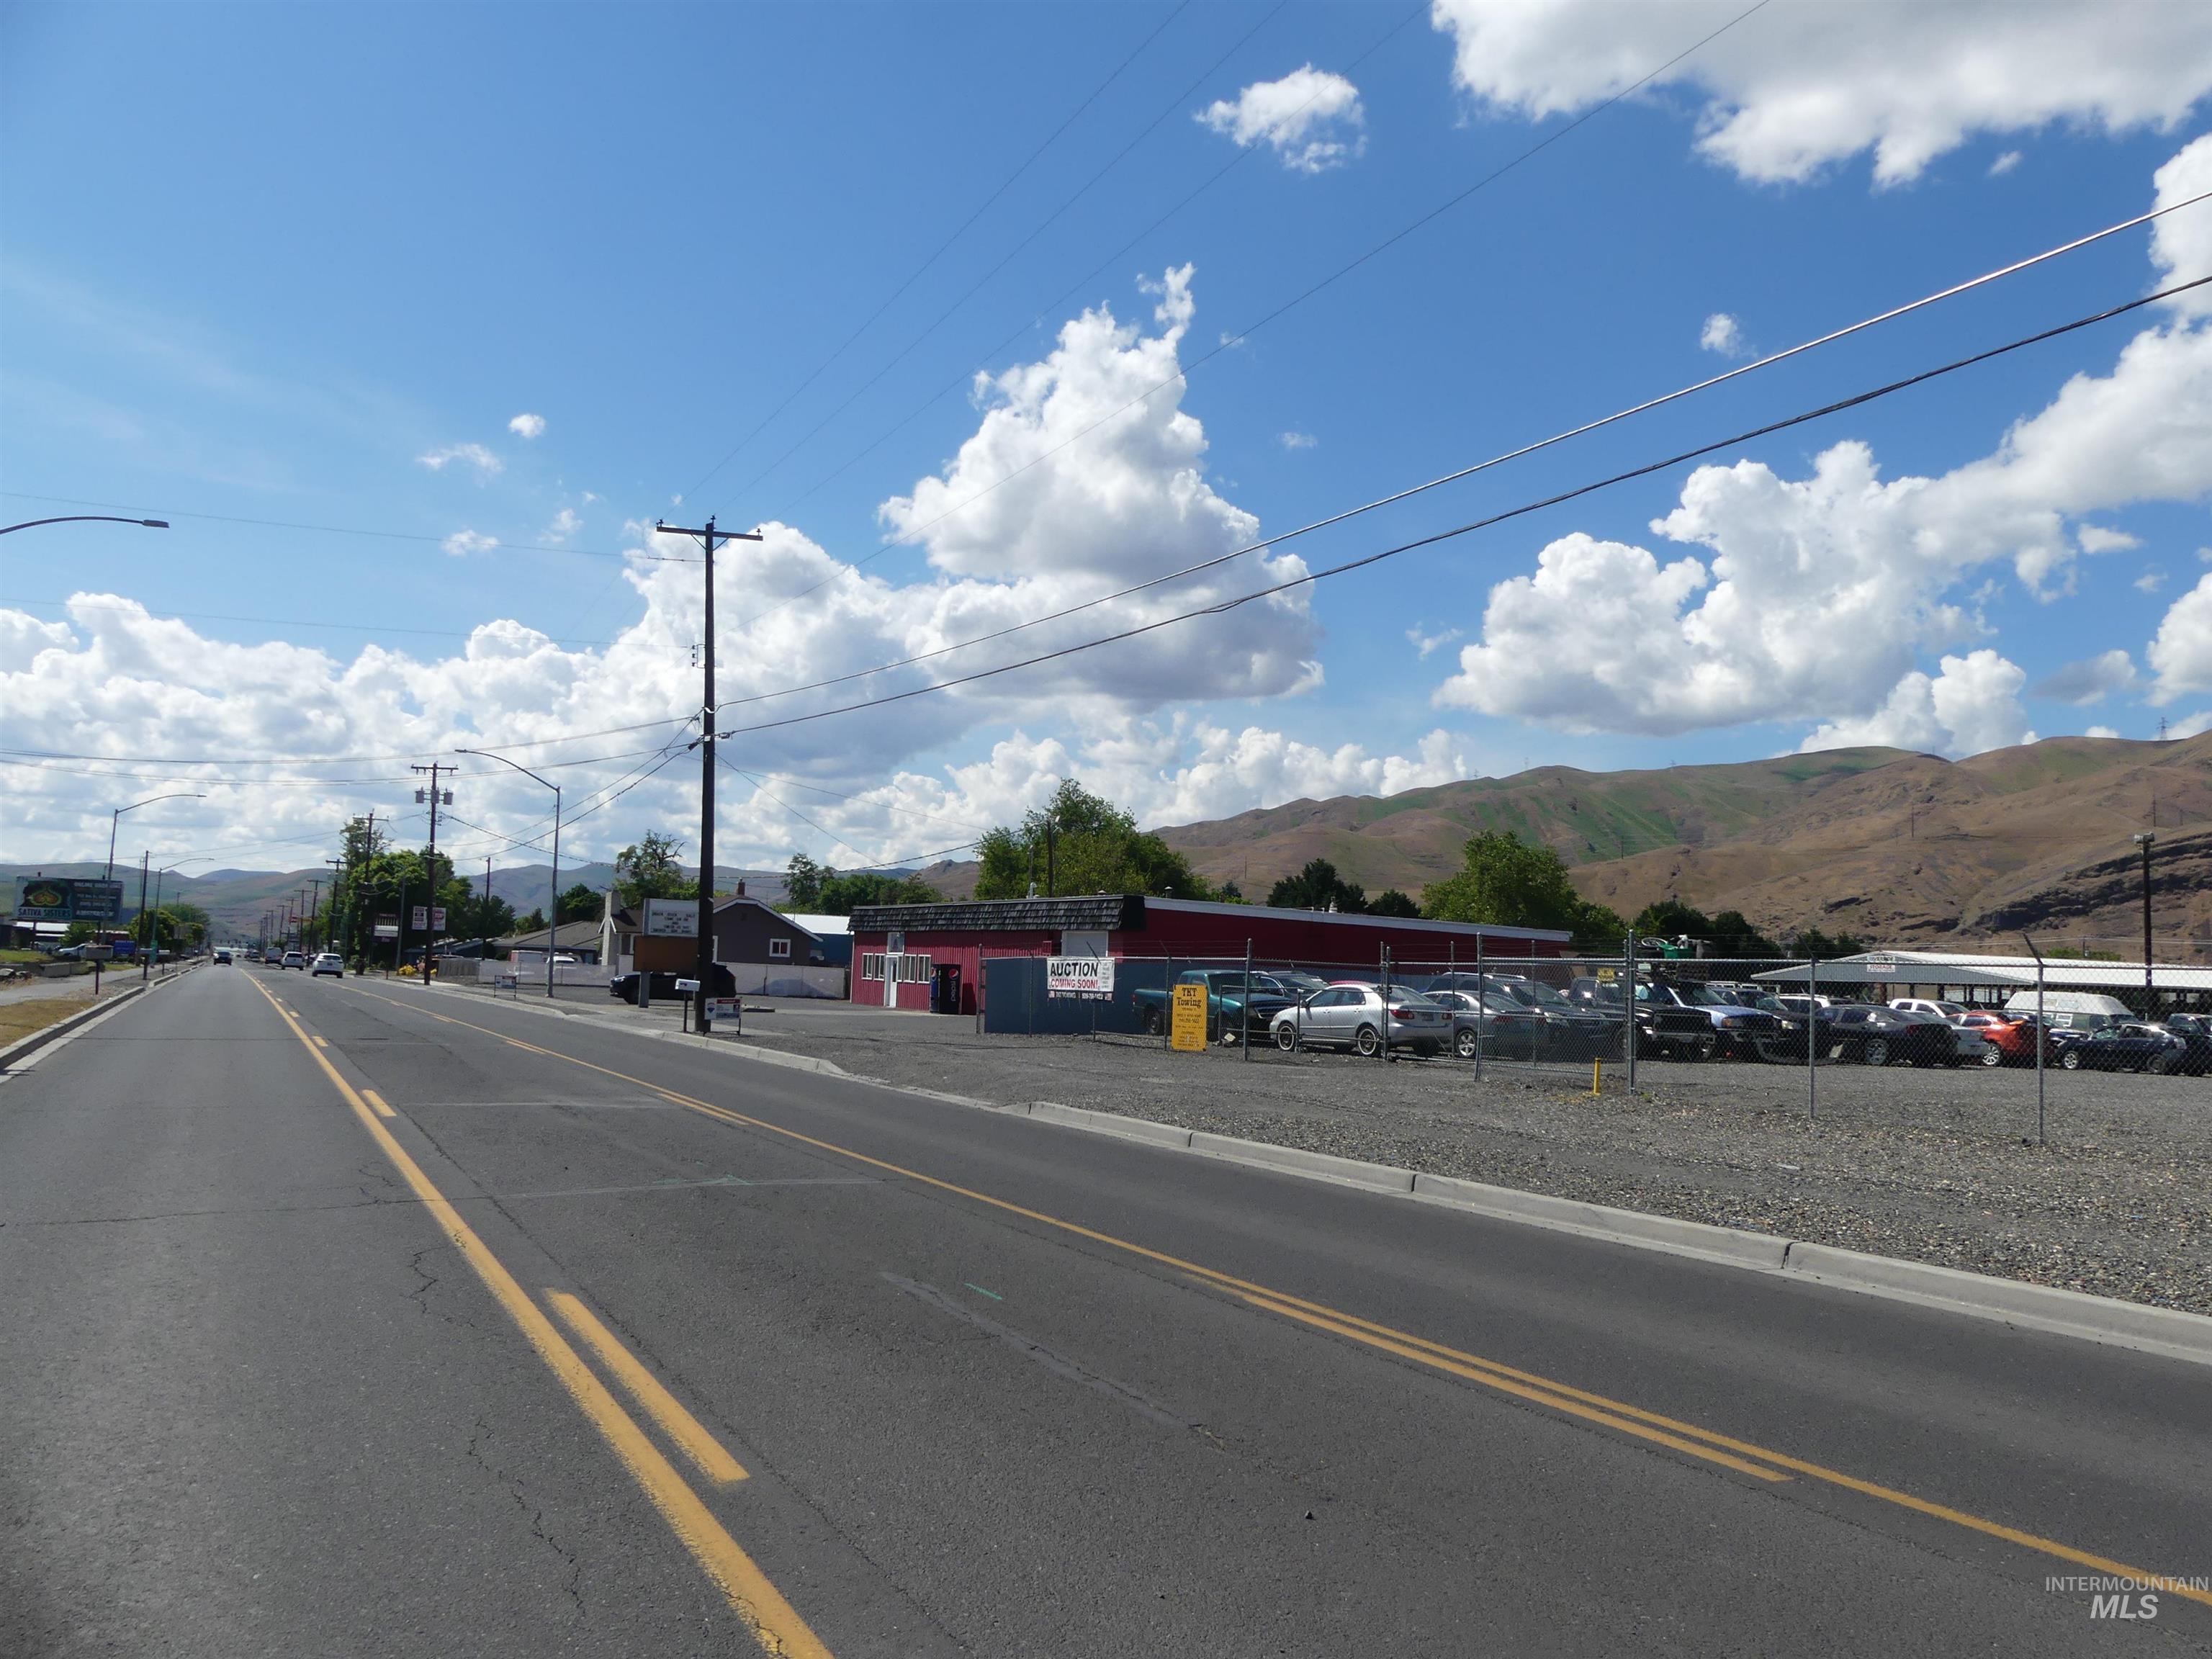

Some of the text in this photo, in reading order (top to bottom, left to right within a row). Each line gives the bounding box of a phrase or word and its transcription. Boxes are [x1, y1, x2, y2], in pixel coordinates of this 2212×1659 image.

[18, 908, 71, 917] SATIVA SISTERS
[1051, 962, 1099, 977] AUCTION
[1051, 979, 1098, 989] COMING SOON!
[1182, 988, 1197, 997] TKT
[1177, 997, 1202, 1008] Towing
